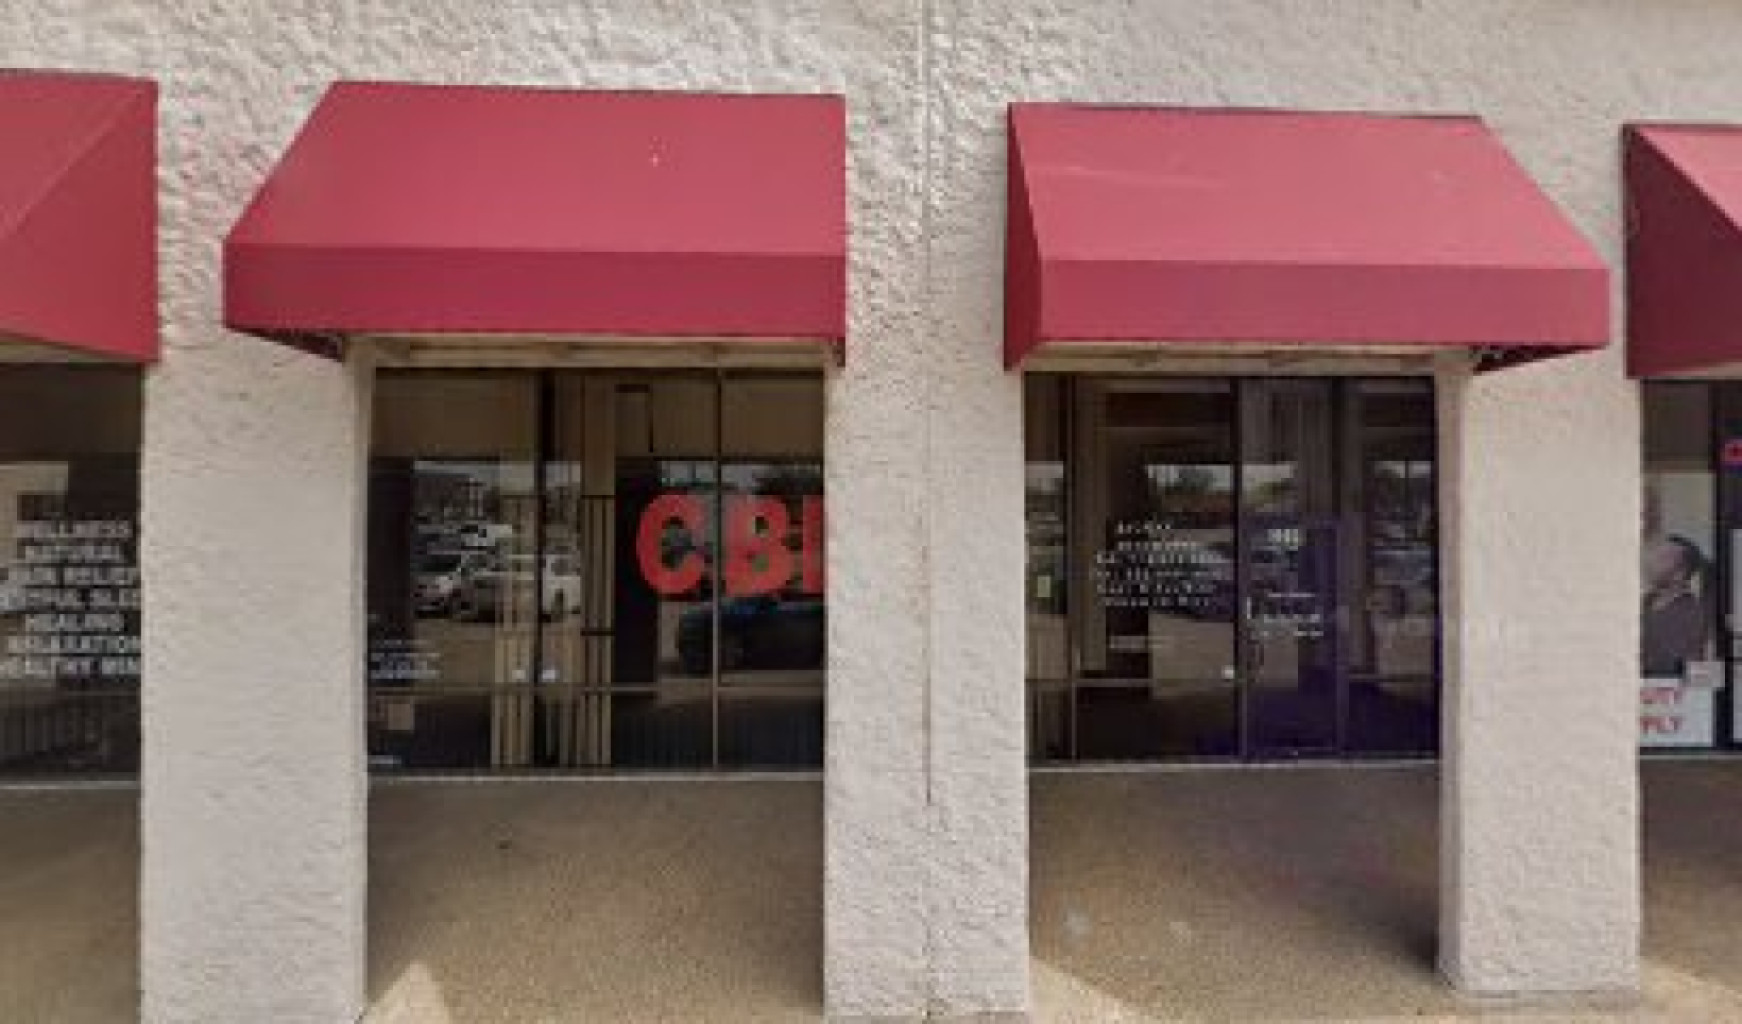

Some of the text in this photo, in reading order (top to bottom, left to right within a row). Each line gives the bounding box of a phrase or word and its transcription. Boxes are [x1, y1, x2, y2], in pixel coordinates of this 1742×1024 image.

[100, 656, 142, 676] MIN
[1638, 686, 1682, 705] UTY
[1638, 715, 1683, 735] PLY
